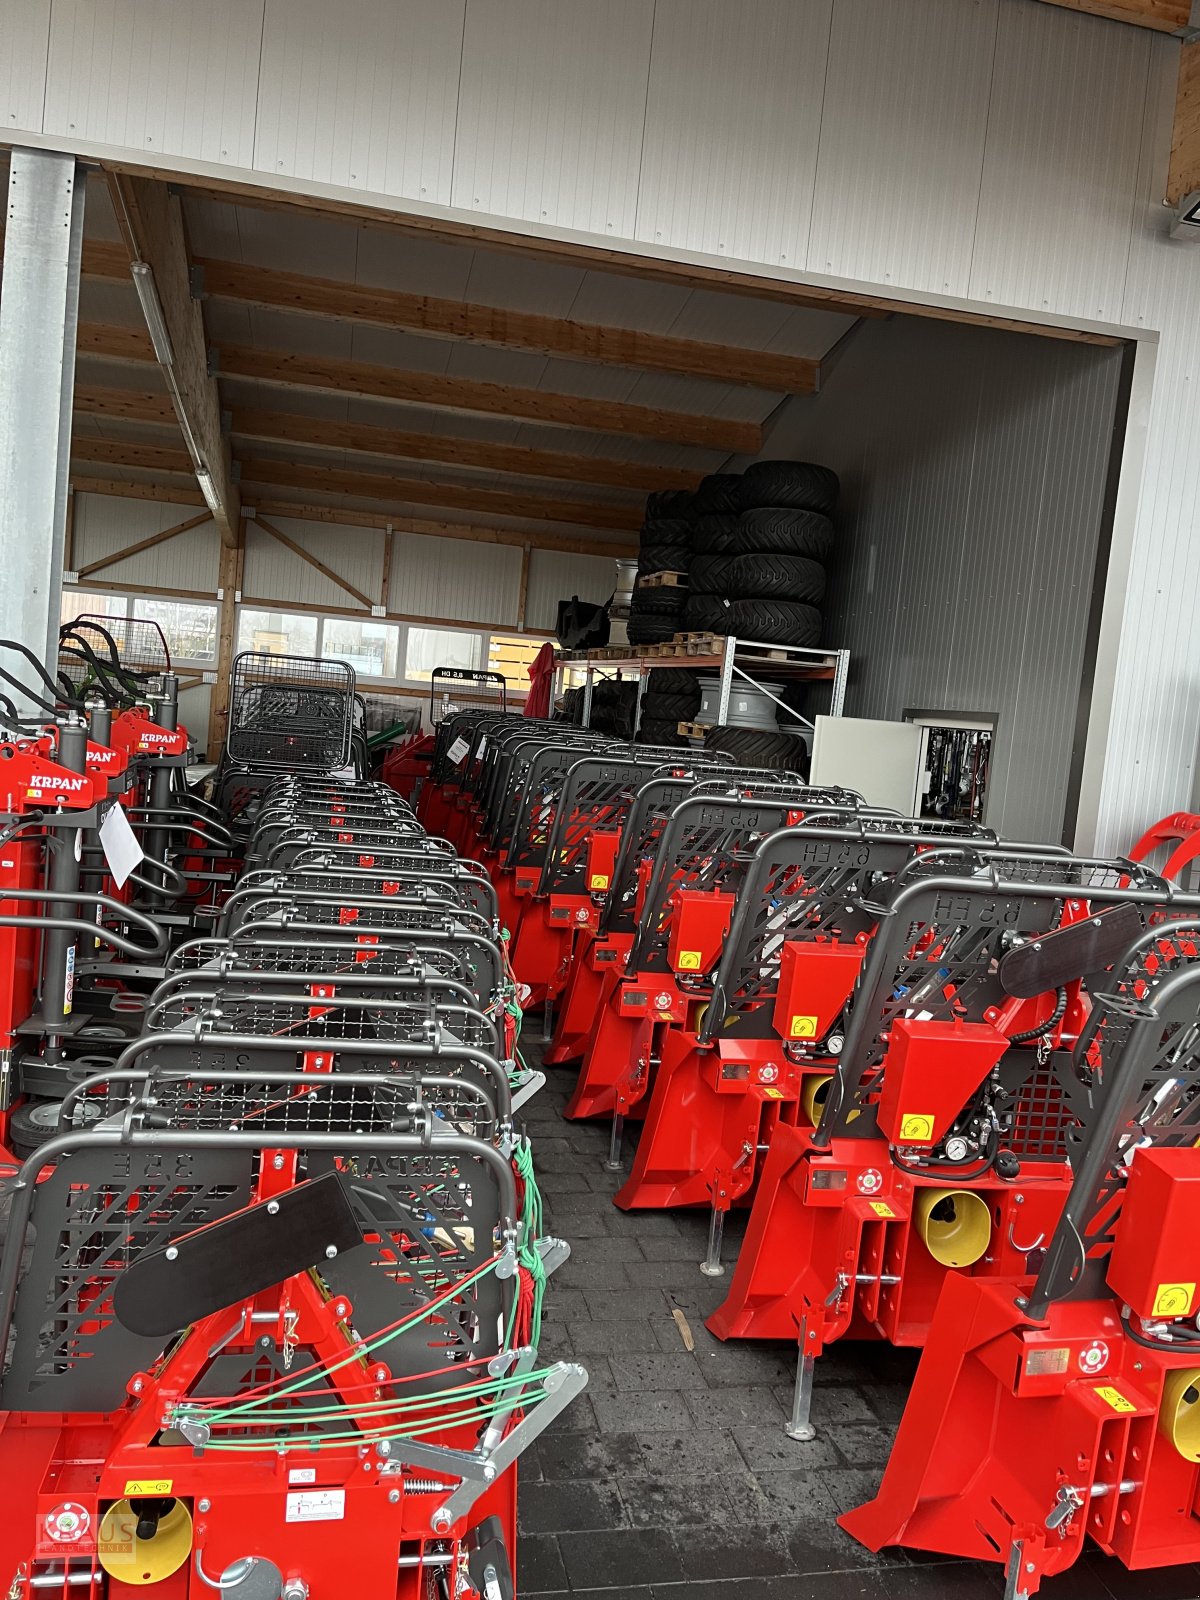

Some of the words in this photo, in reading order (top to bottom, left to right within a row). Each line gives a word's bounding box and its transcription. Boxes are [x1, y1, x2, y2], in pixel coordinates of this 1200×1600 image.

[140, 733, 177, 744] KRPAN
[86, 751, 112, 763] PAN
[30, 775, 83, 791] KRPAN
